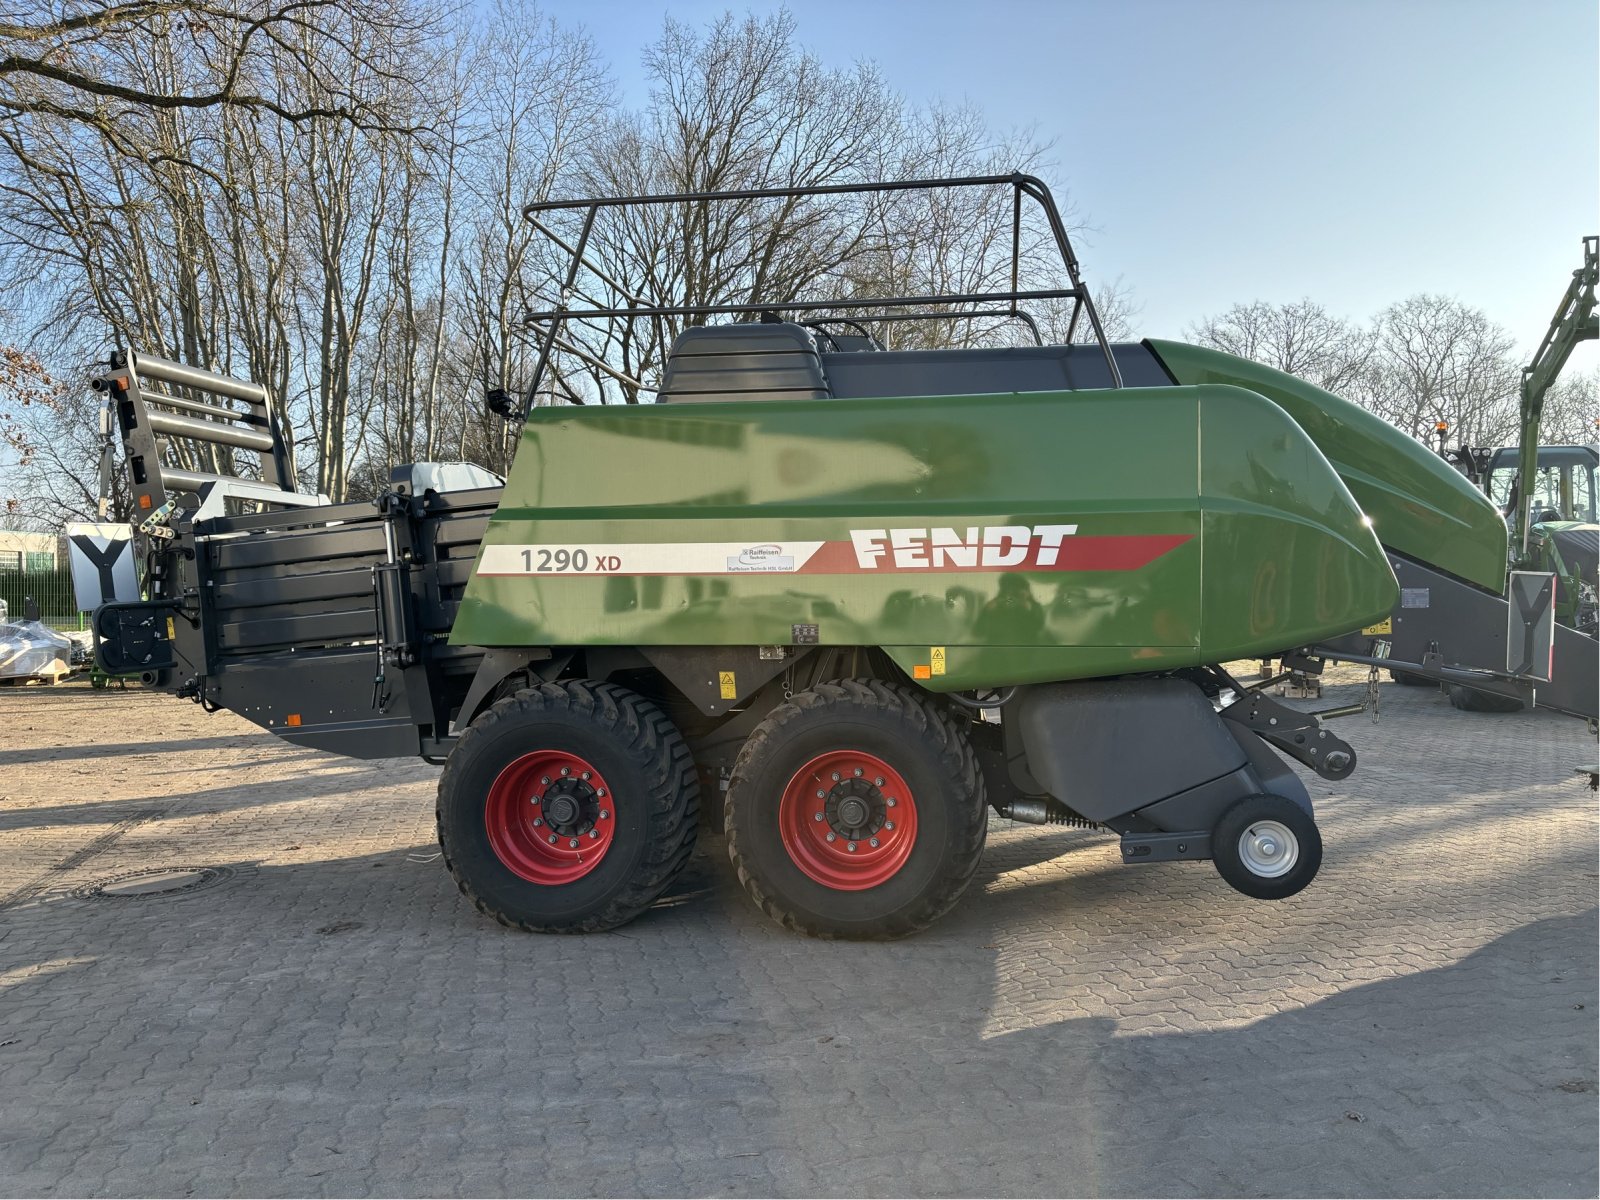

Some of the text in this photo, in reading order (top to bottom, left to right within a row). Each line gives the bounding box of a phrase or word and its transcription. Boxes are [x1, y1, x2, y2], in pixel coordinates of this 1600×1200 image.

[521, 549, 622, 572] 1290 XD
[850, 524, 1078, 568] FENDT
